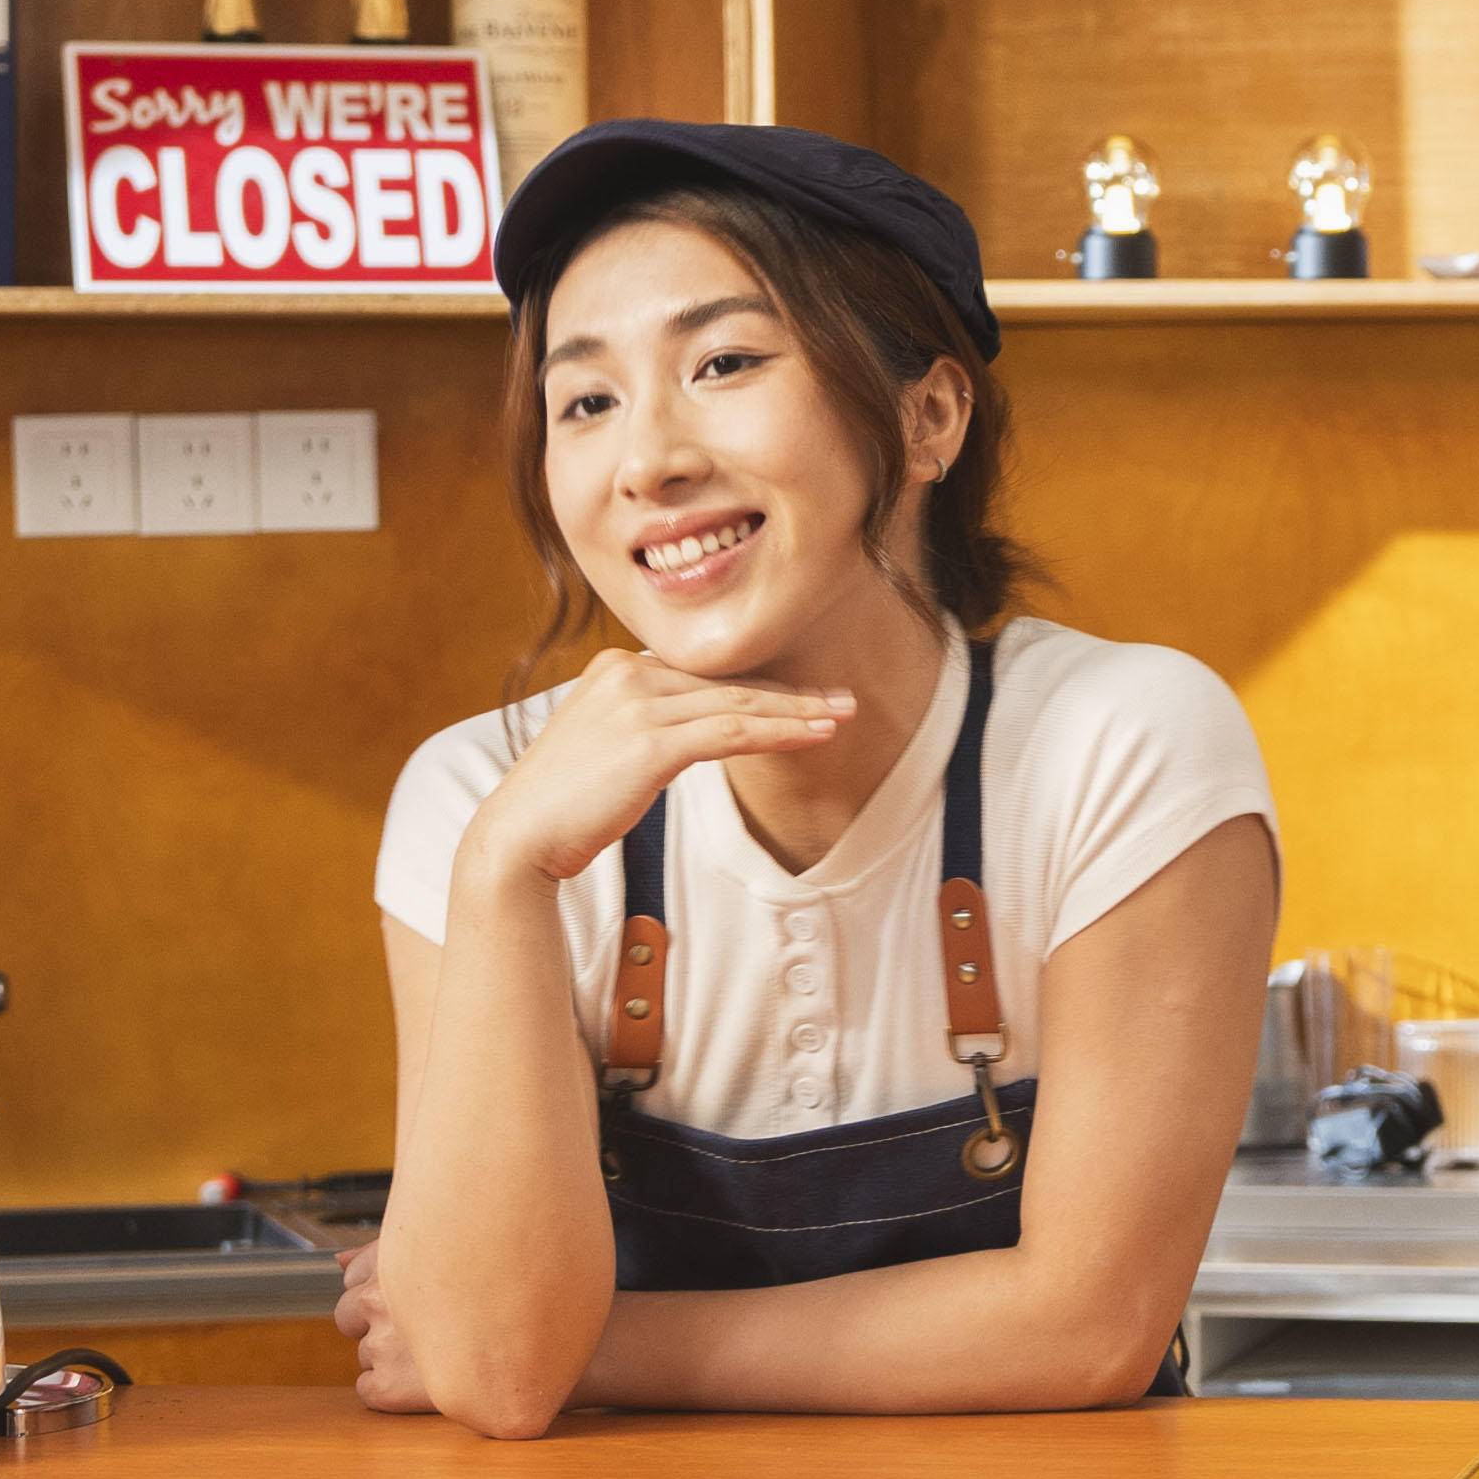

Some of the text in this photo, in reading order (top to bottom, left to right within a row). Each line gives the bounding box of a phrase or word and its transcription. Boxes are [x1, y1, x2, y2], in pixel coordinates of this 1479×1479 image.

[88, 77, 473, 147] Sorry WE'RE
[89, 143, 486, 270] CLOSED
